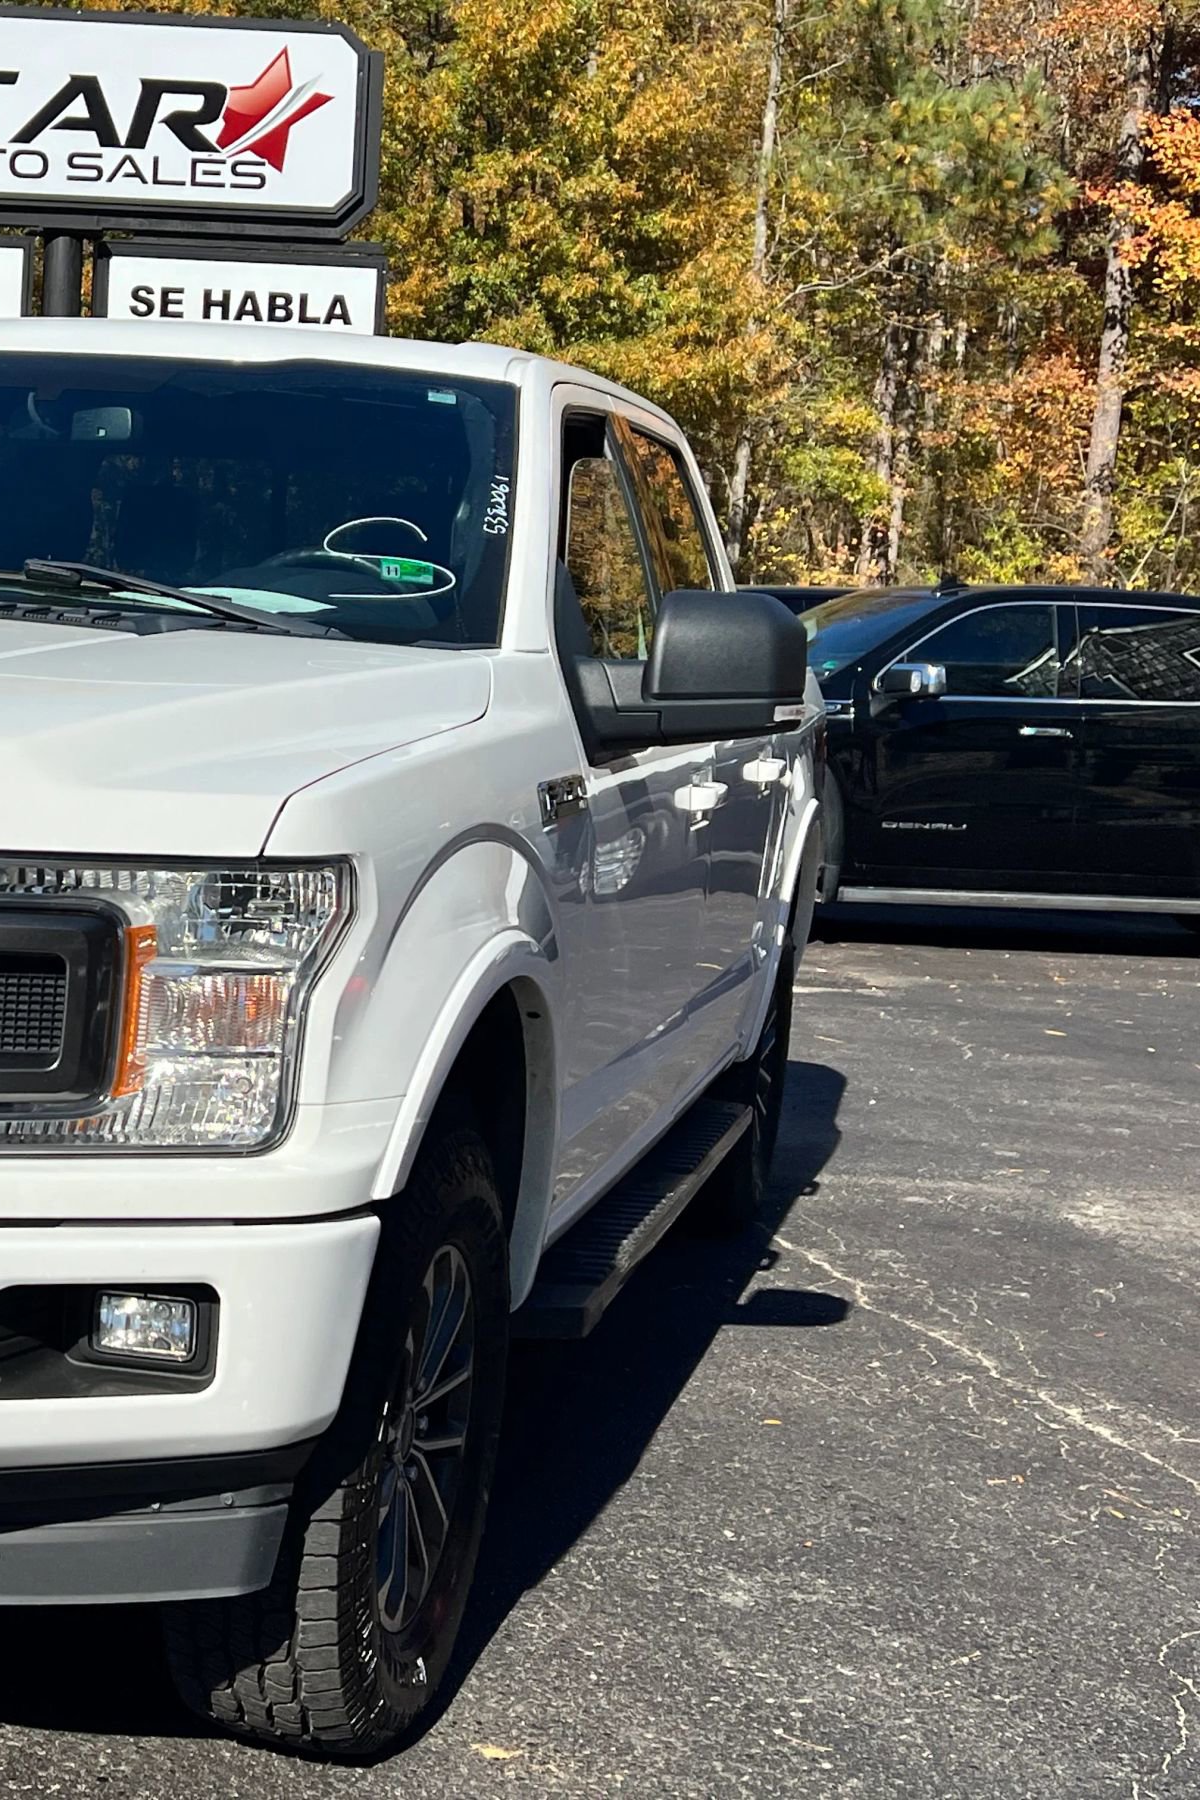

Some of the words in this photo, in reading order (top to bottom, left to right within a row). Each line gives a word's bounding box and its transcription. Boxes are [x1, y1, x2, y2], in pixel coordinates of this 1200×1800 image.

[66, 151, 266, 189] SALES
[129, 285, 185, 318] SE
[202, 288, 352, 325] HABLA
